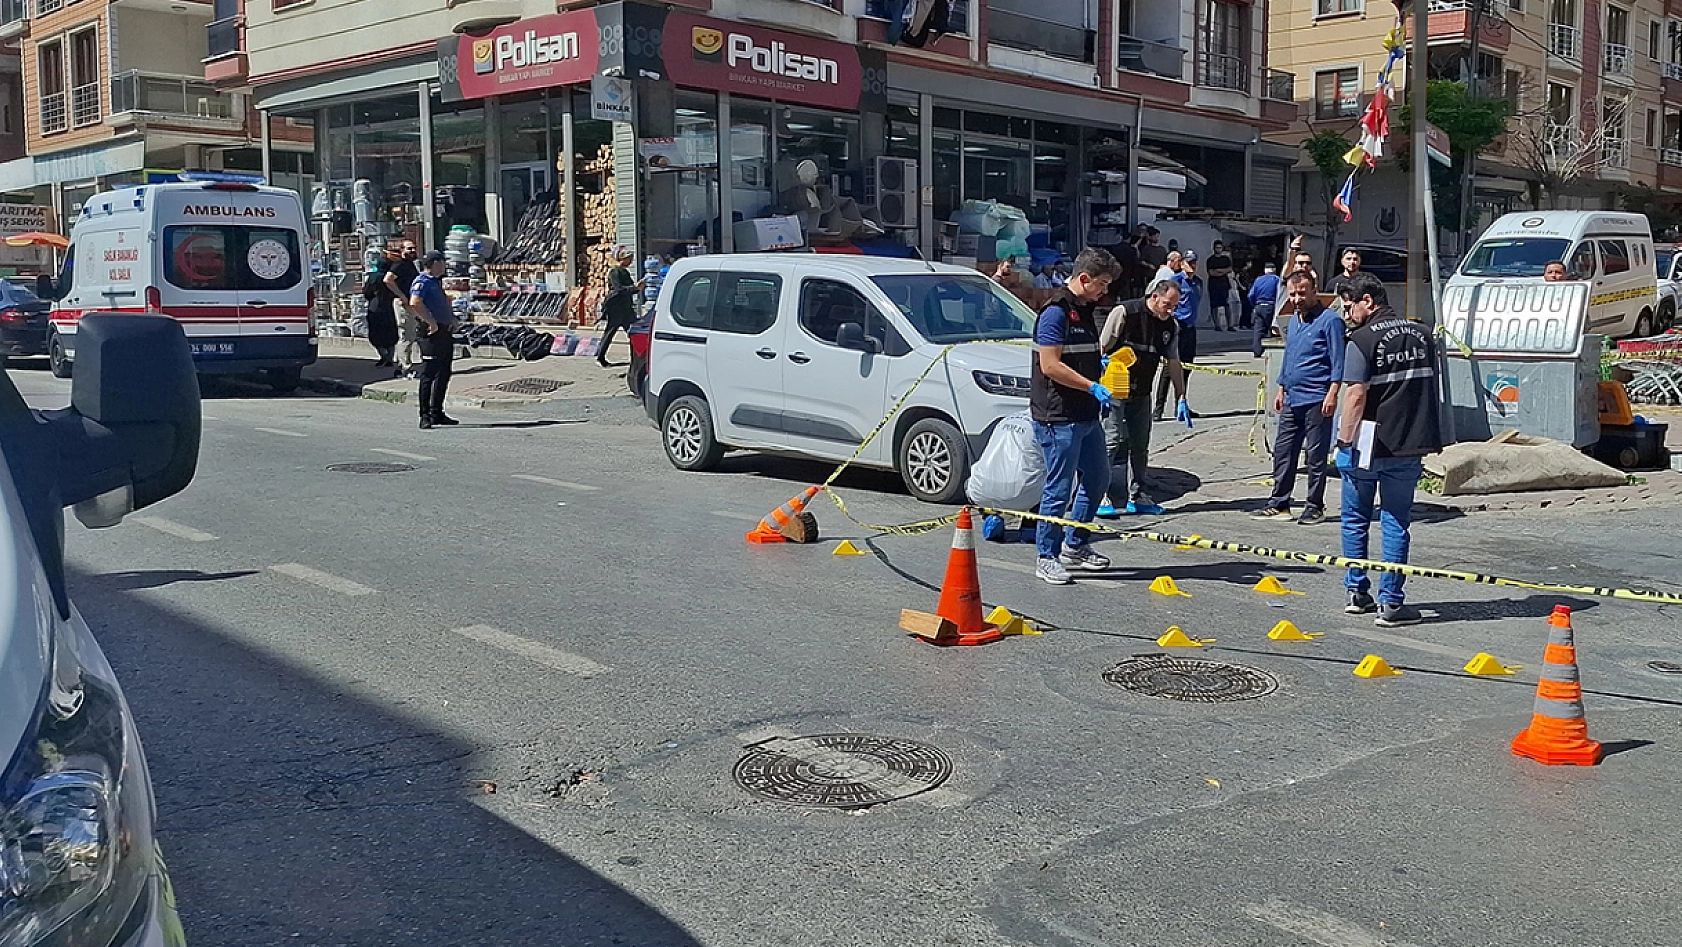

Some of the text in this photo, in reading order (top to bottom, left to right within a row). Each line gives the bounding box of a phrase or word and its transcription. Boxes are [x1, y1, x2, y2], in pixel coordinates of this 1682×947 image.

[496, 30, 579, 70] Polisan
[727, 33, 838, 84] Polisan
[532, 67, 554, 78] MARKET
[776, 80, 805, 92] MARKET
[183, 205, 276, 218] AMBULANS
[10, 216, 45, 227] SERVİS
[1386, 345, 1426, 365] POLİS
